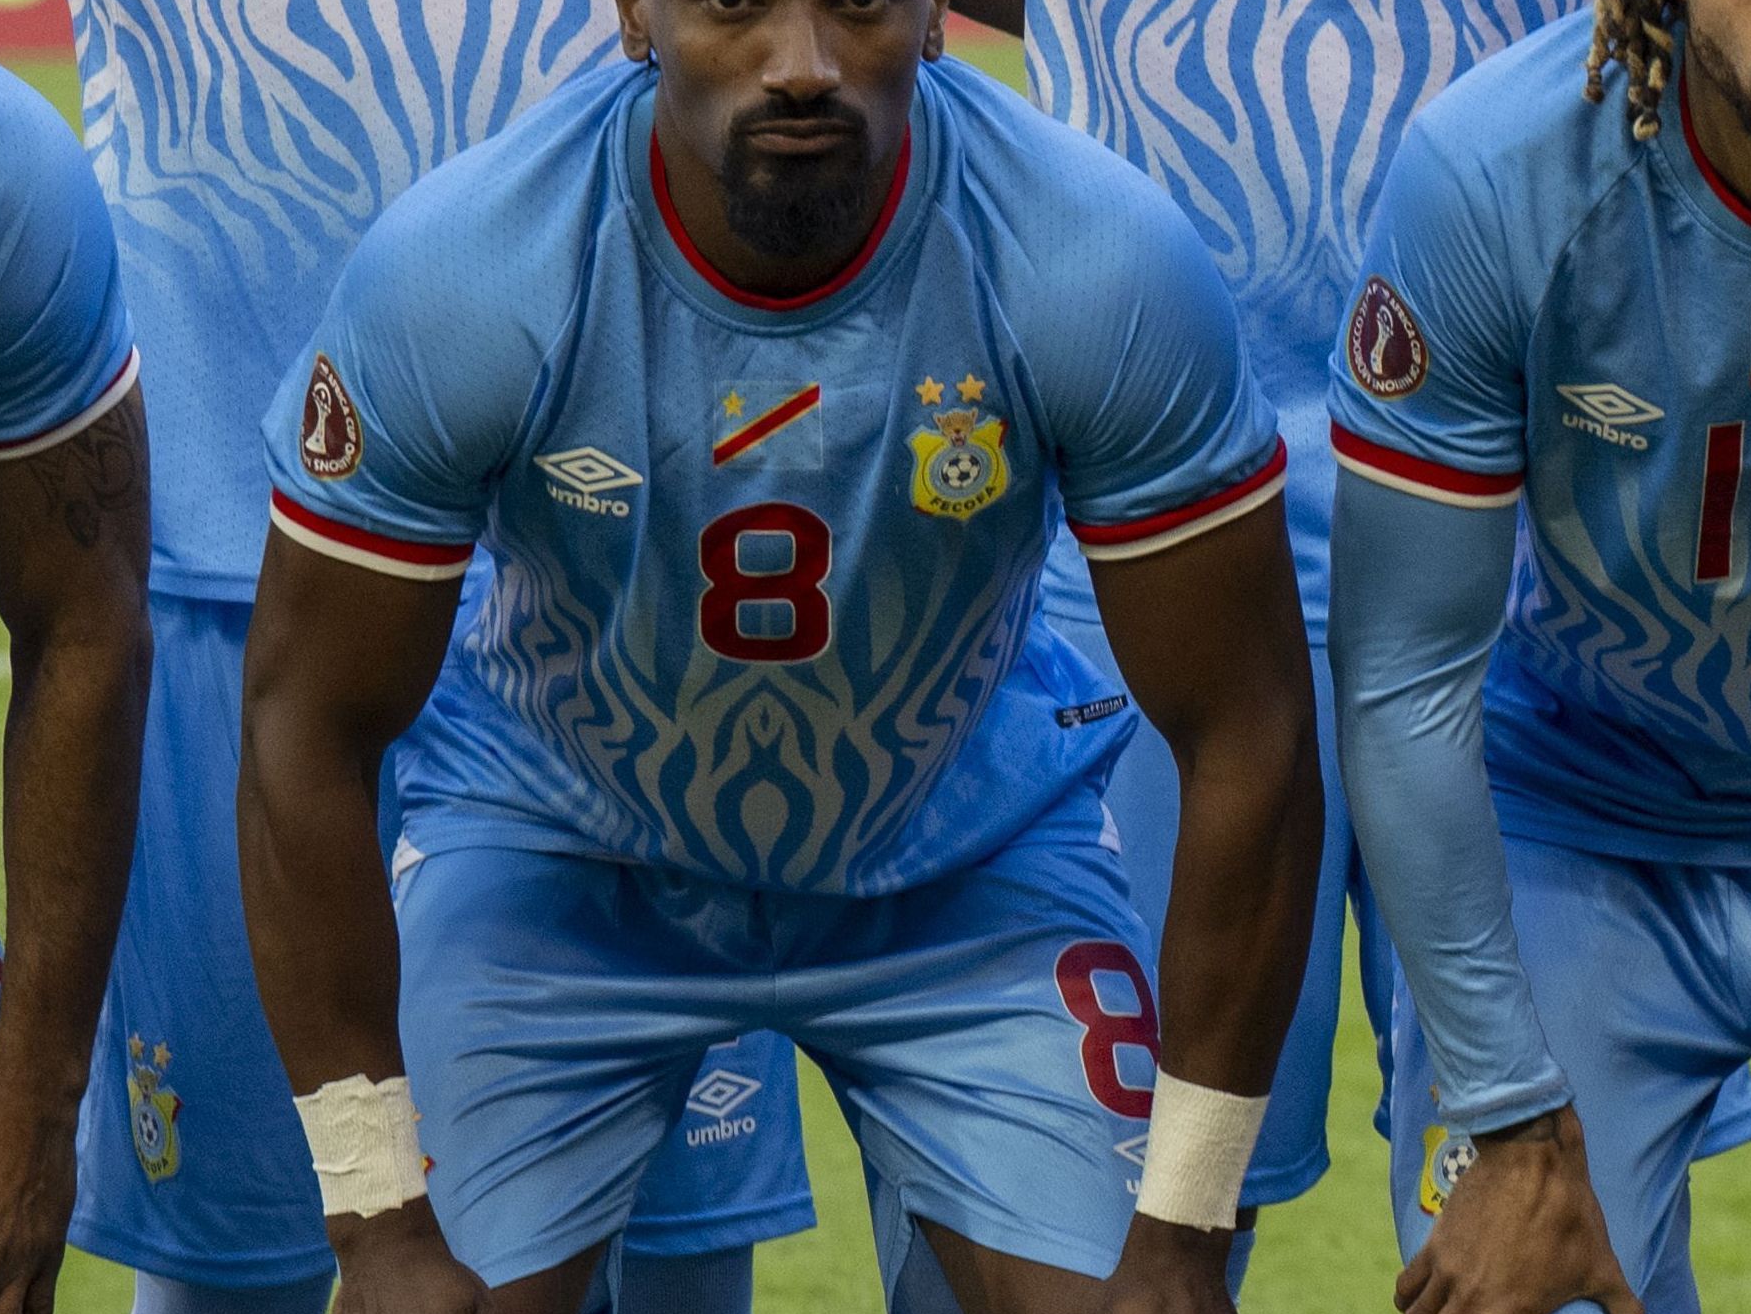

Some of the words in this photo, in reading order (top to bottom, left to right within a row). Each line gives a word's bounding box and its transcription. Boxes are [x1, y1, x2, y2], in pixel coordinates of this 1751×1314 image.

[1562, 412, 1648, 450] umbro
[546, 480, 629, 517] umbro
[930, 486, 996, 511] FECOFA
[697, 502, 832, 663] 8
[1054, 941, 1161, 1120] 8
[687, 1116, 756, 1147] umbro
